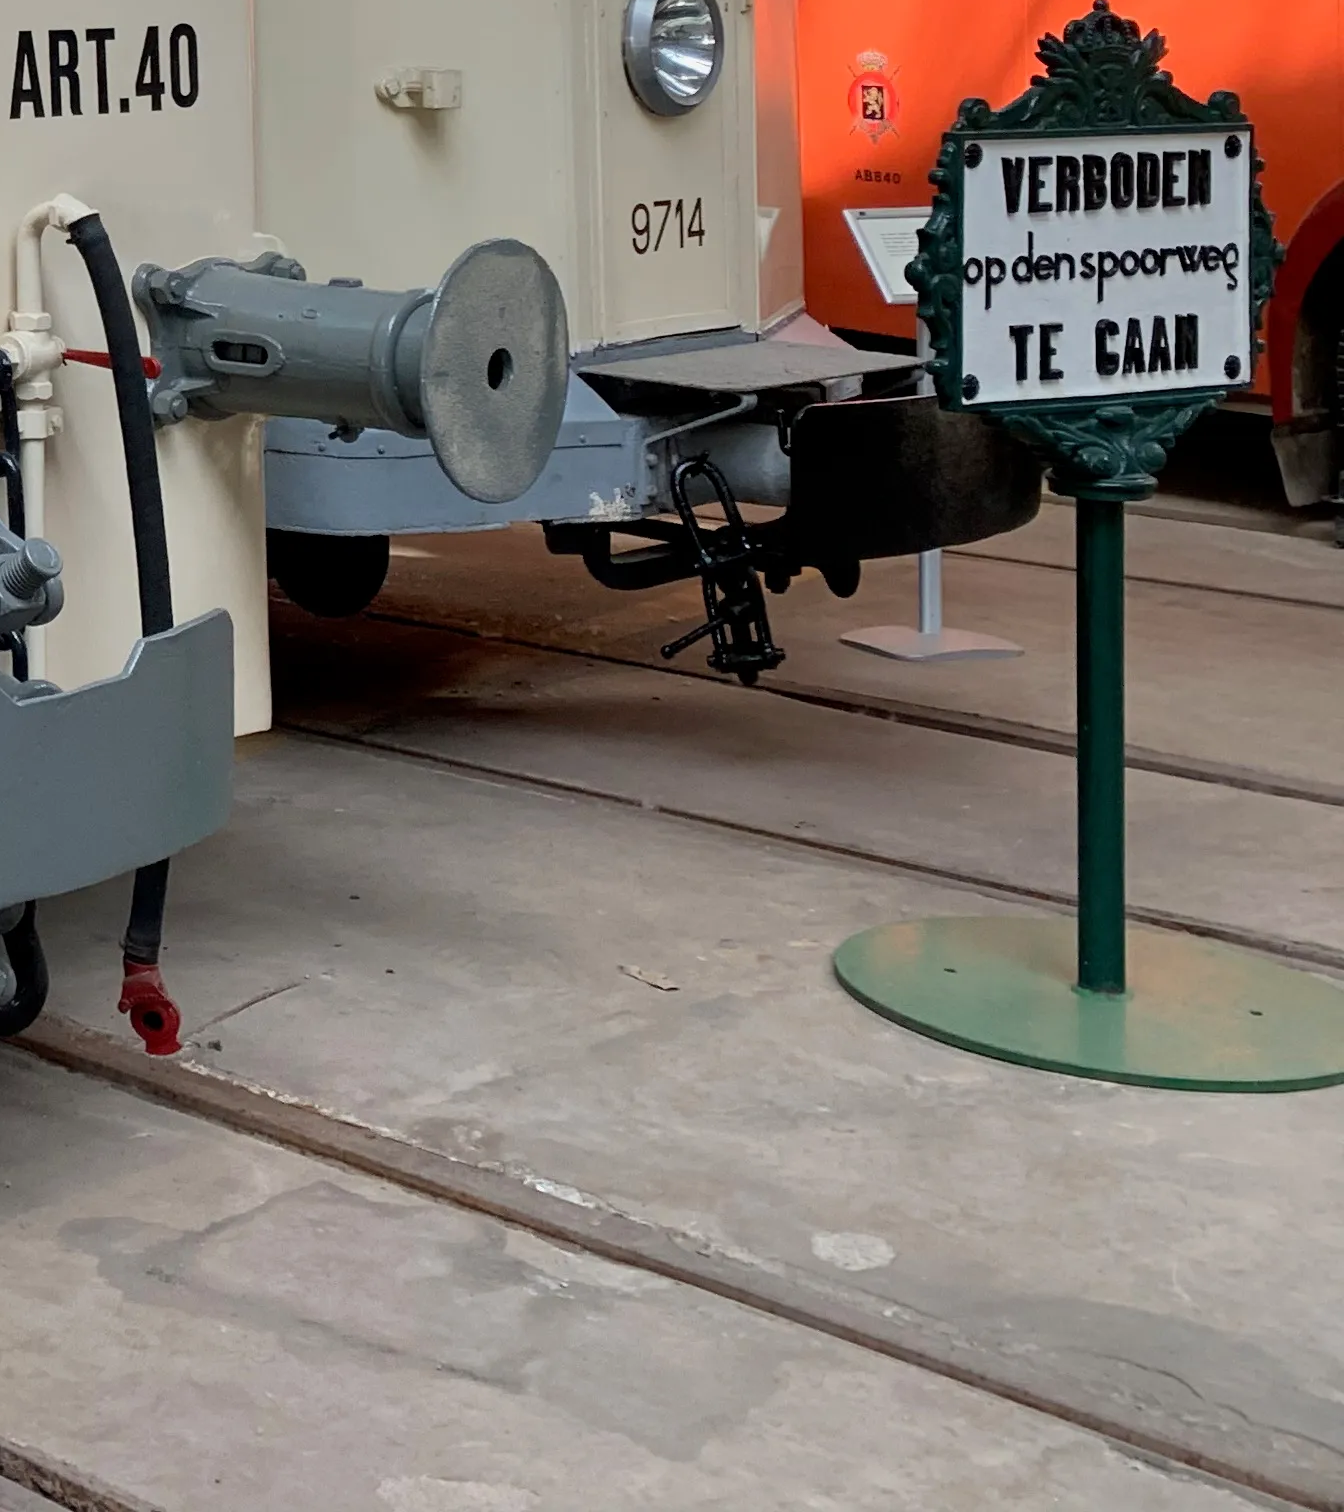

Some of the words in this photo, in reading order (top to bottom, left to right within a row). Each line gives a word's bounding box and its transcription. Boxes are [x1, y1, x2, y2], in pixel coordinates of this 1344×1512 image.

[9, 22, 200, 120] ART.40
[1000, 148, 1212, 215] VERBODEN
[631, 197, 706, 255] 9714
[963, 255, 1007, 310] op
[1011, 231, 1076, 284] den
[1079, 242, 1240, 304] spoorweg
[1008, 322, 1064, 381] TE
[1094, 313, 1200, 376] GAAN
